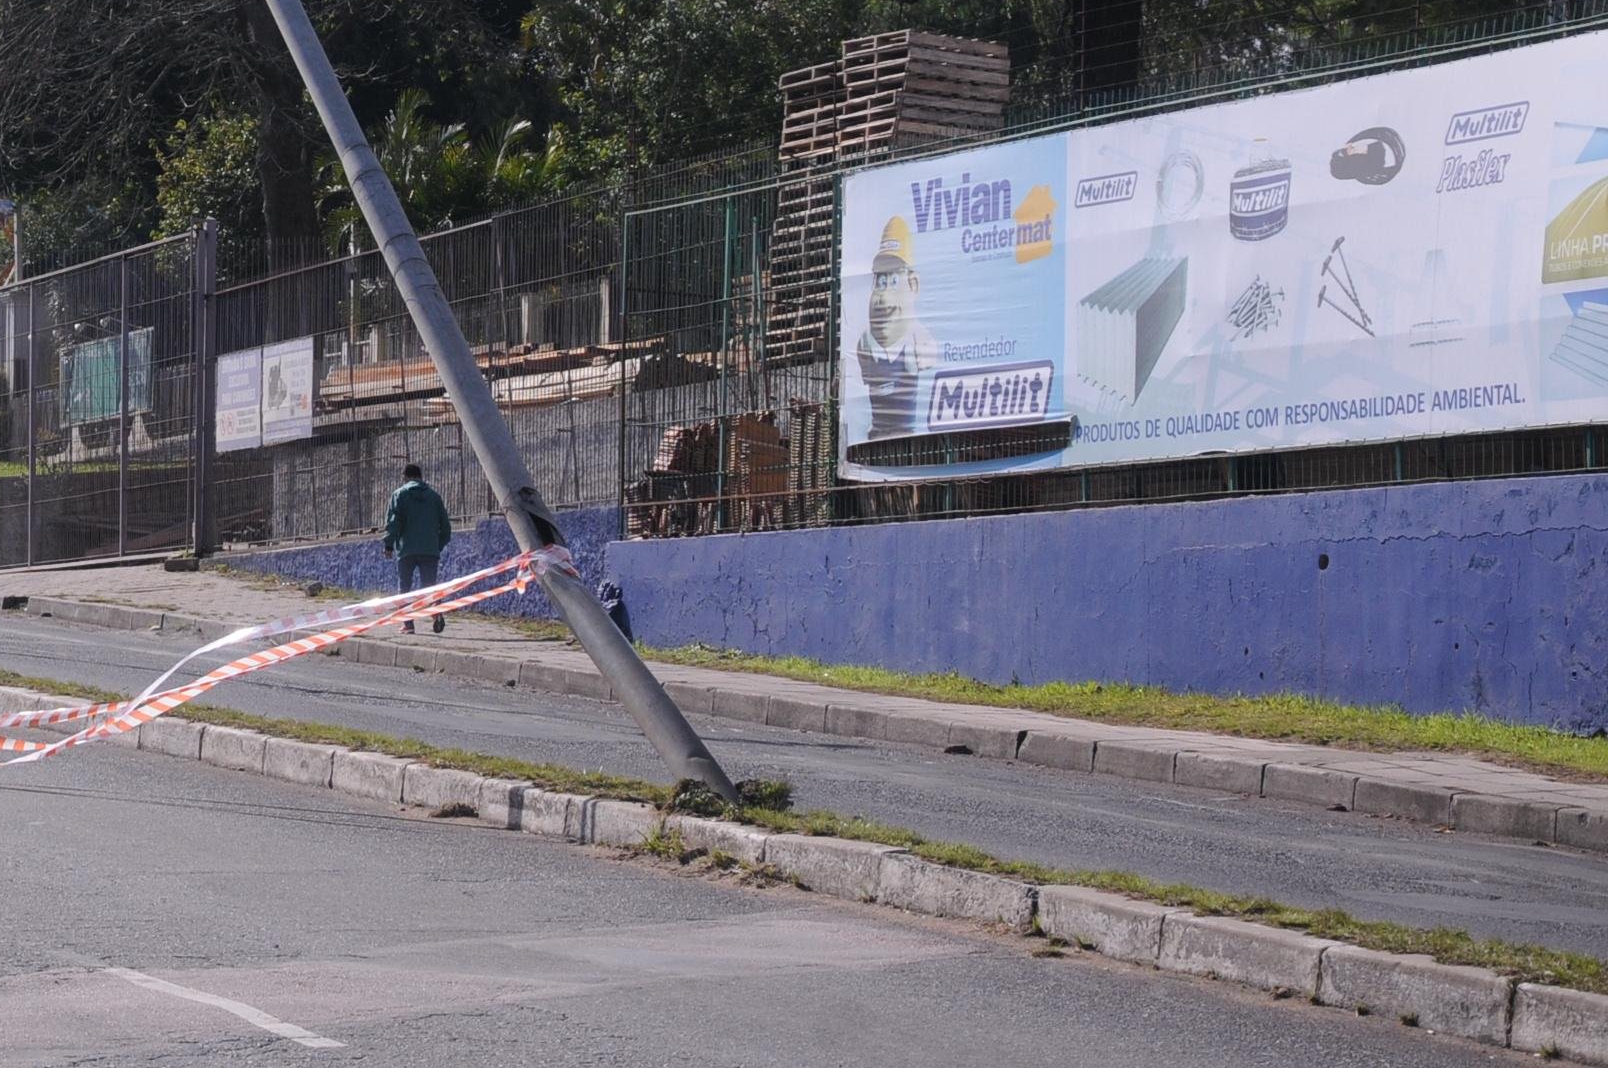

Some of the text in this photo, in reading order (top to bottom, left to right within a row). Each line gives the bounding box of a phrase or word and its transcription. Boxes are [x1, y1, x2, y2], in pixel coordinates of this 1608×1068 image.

[1450, 107, 1523, 140] Multilit
[911, 172, 1013, 233] Vivian
[1079, 176, 1133, 204] Multilit
[1232, 184, 1286, 214] Multilit
[1550, 237, 1590, 261] LINHA
[943, 335, 1018, 362] Revendedor
[936, 372, 1044, 421] Multilit
[1075, 382, 1526, 444] PRODUTOS DE QUALIDADE COM RESPONSABILIDADE AMBIENTAL.
